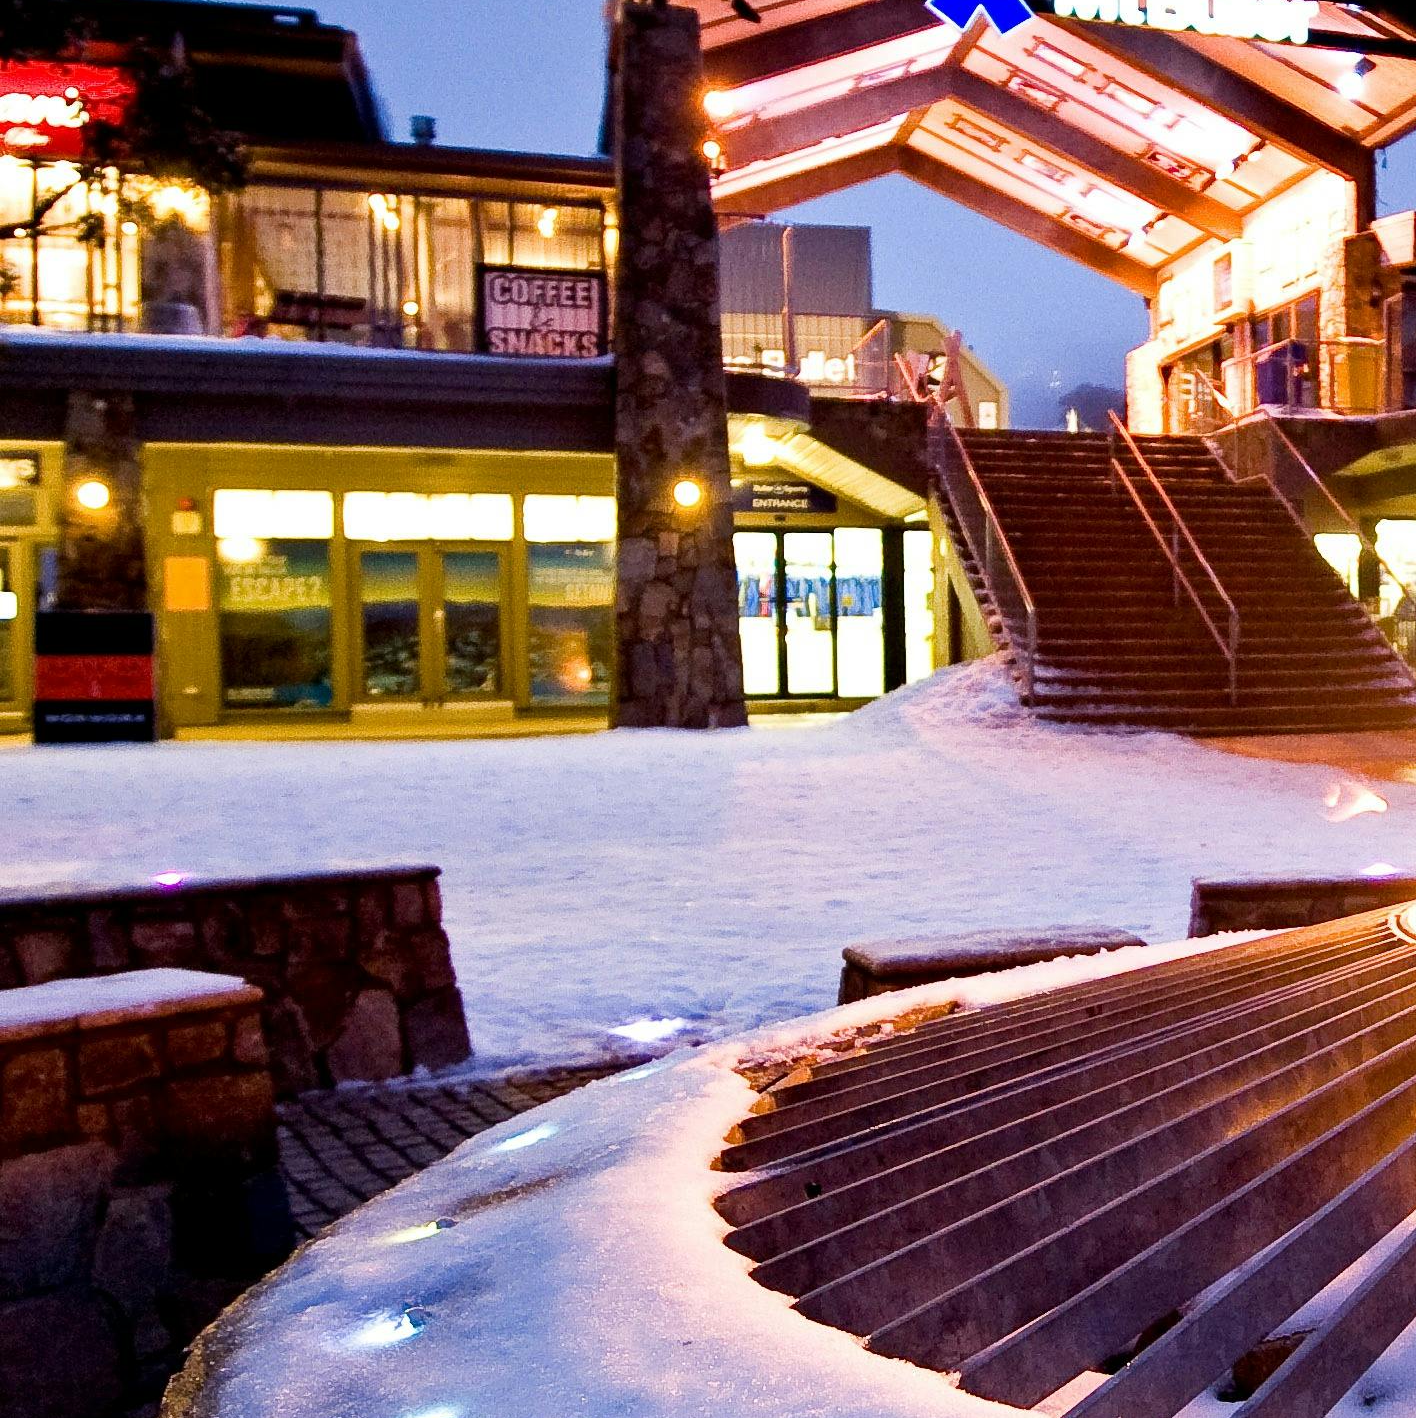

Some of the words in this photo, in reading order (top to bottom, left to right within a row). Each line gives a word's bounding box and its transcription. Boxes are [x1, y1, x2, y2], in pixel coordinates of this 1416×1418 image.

[491, 275, 592, 309] COFFEE
[488, 328, 598, 357] SNACKS
[752, 497, 808, 510] ENTRANCE
